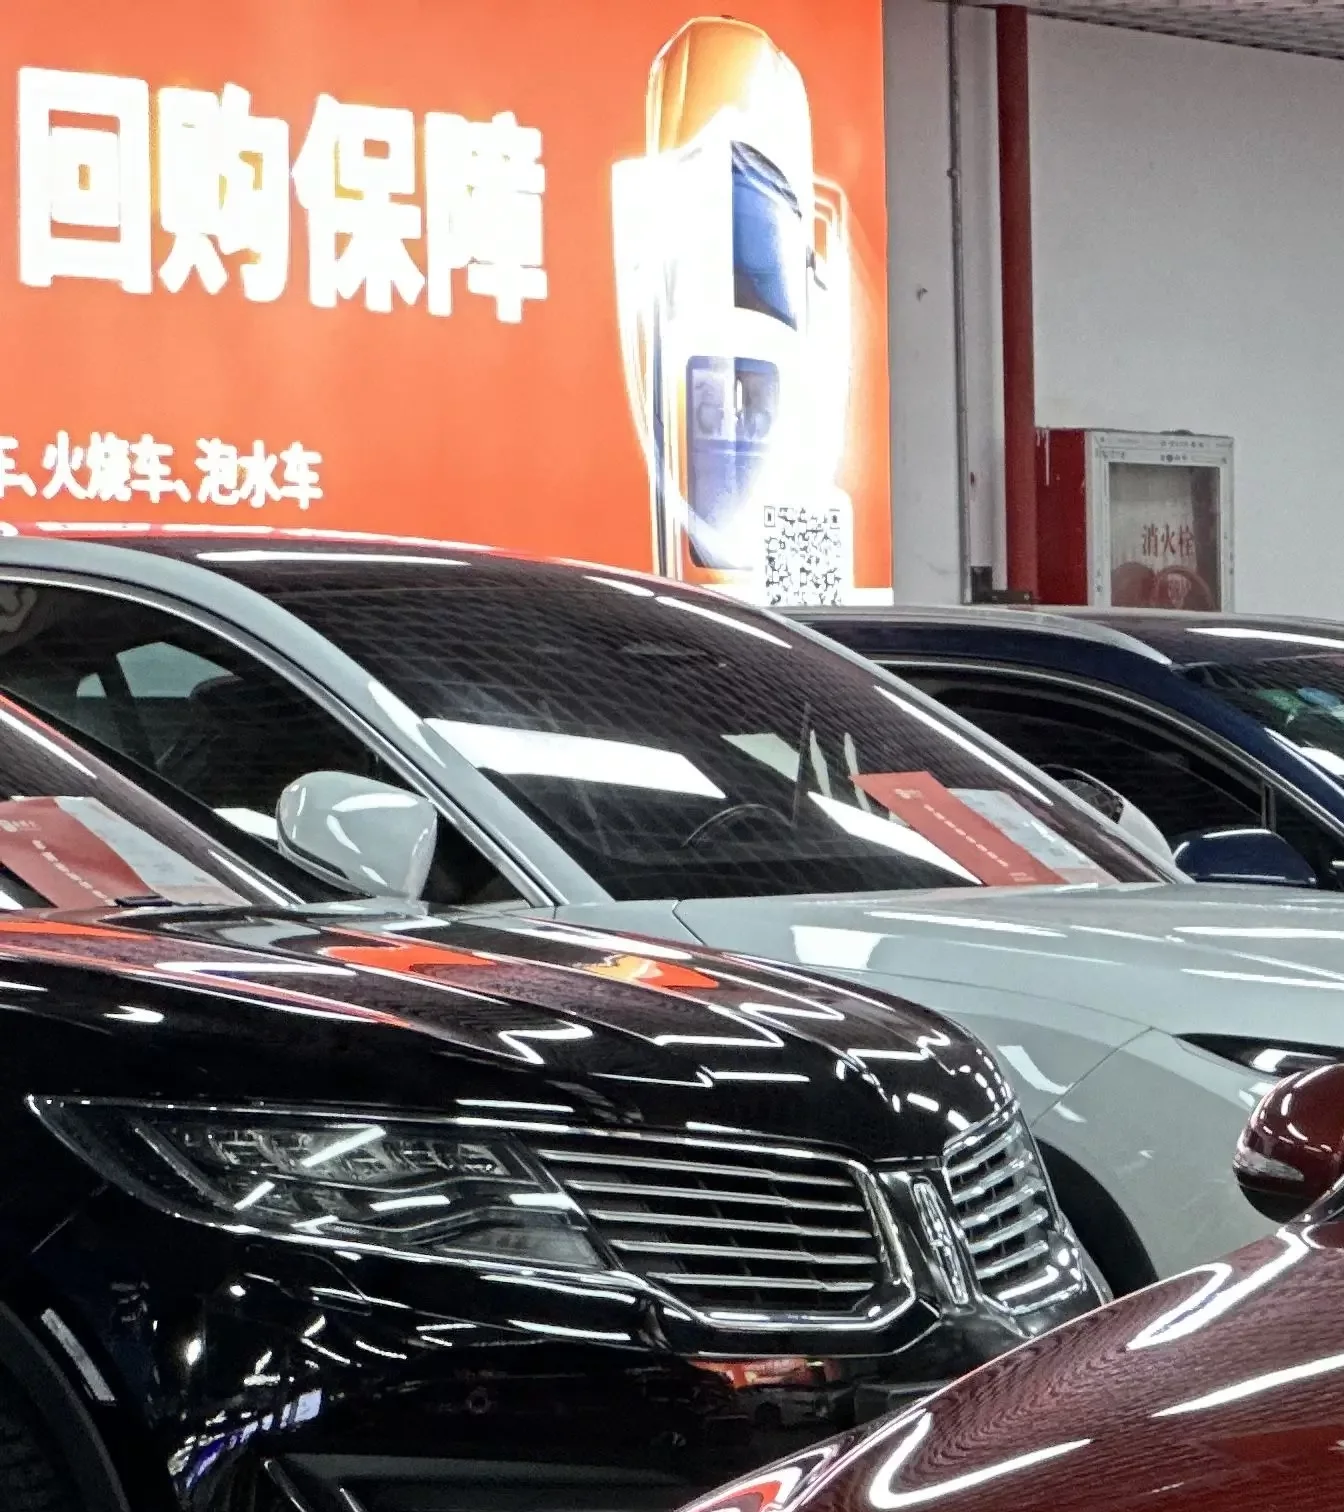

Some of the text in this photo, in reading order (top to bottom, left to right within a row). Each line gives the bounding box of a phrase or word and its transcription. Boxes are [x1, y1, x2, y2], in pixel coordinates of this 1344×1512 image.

[17, 66, 548, 324] 回购保障
[1141, 523, 1197, 558] 消火栓
